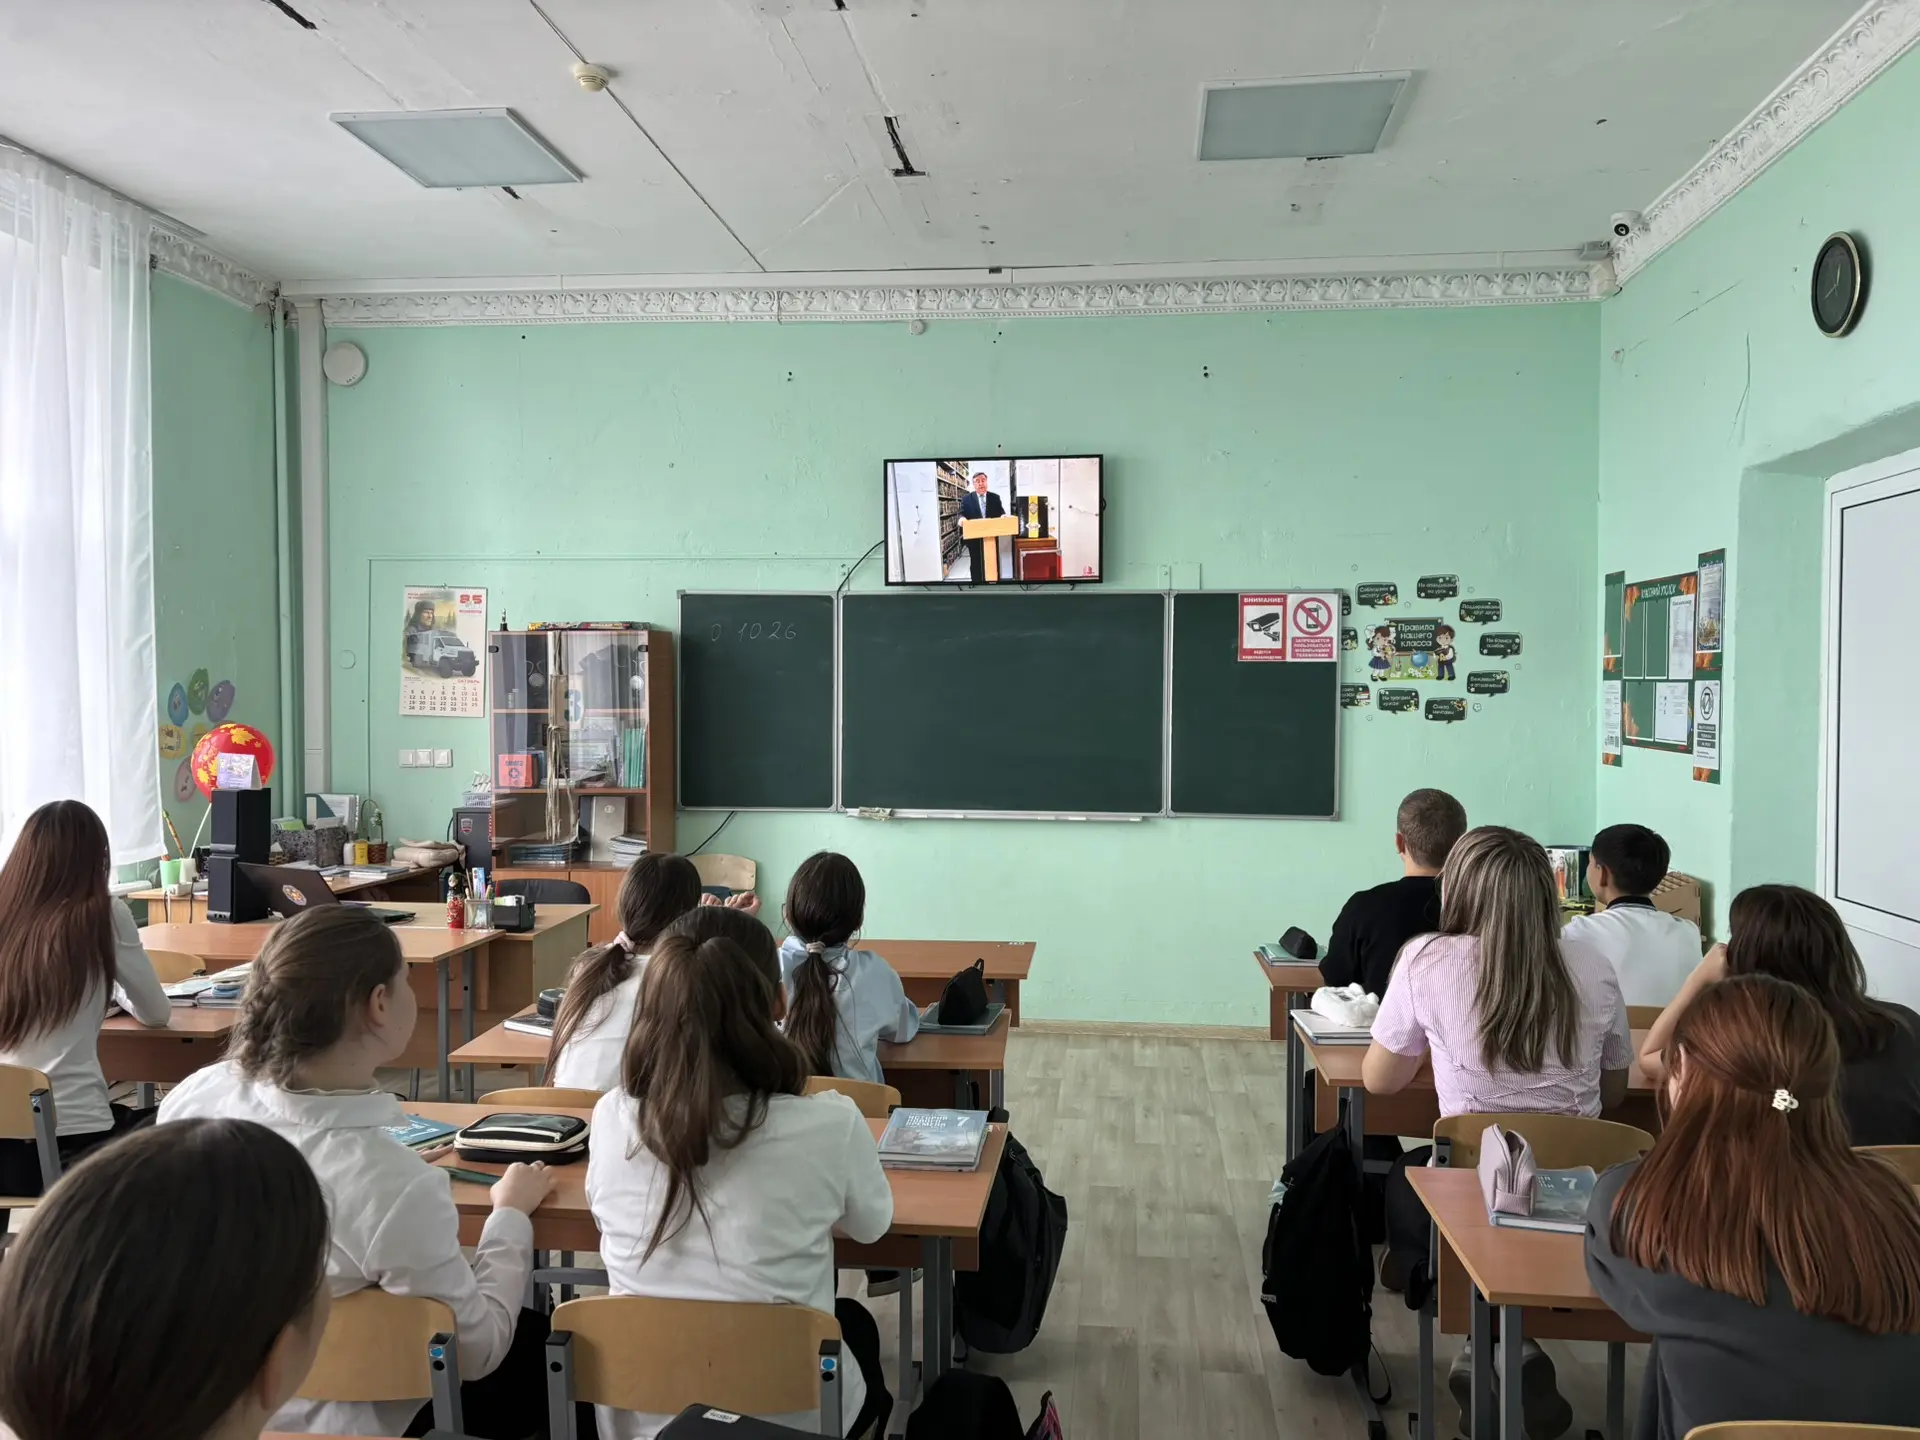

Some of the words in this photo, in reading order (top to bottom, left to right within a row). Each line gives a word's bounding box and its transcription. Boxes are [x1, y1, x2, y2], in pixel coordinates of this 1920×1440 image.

[460, 594, 482, 604] 85
[1398, 623, 1435, 632] Правила
[957, 1116, 970, 1127] 7
[1562, 1177, 1577, 1190] 7
